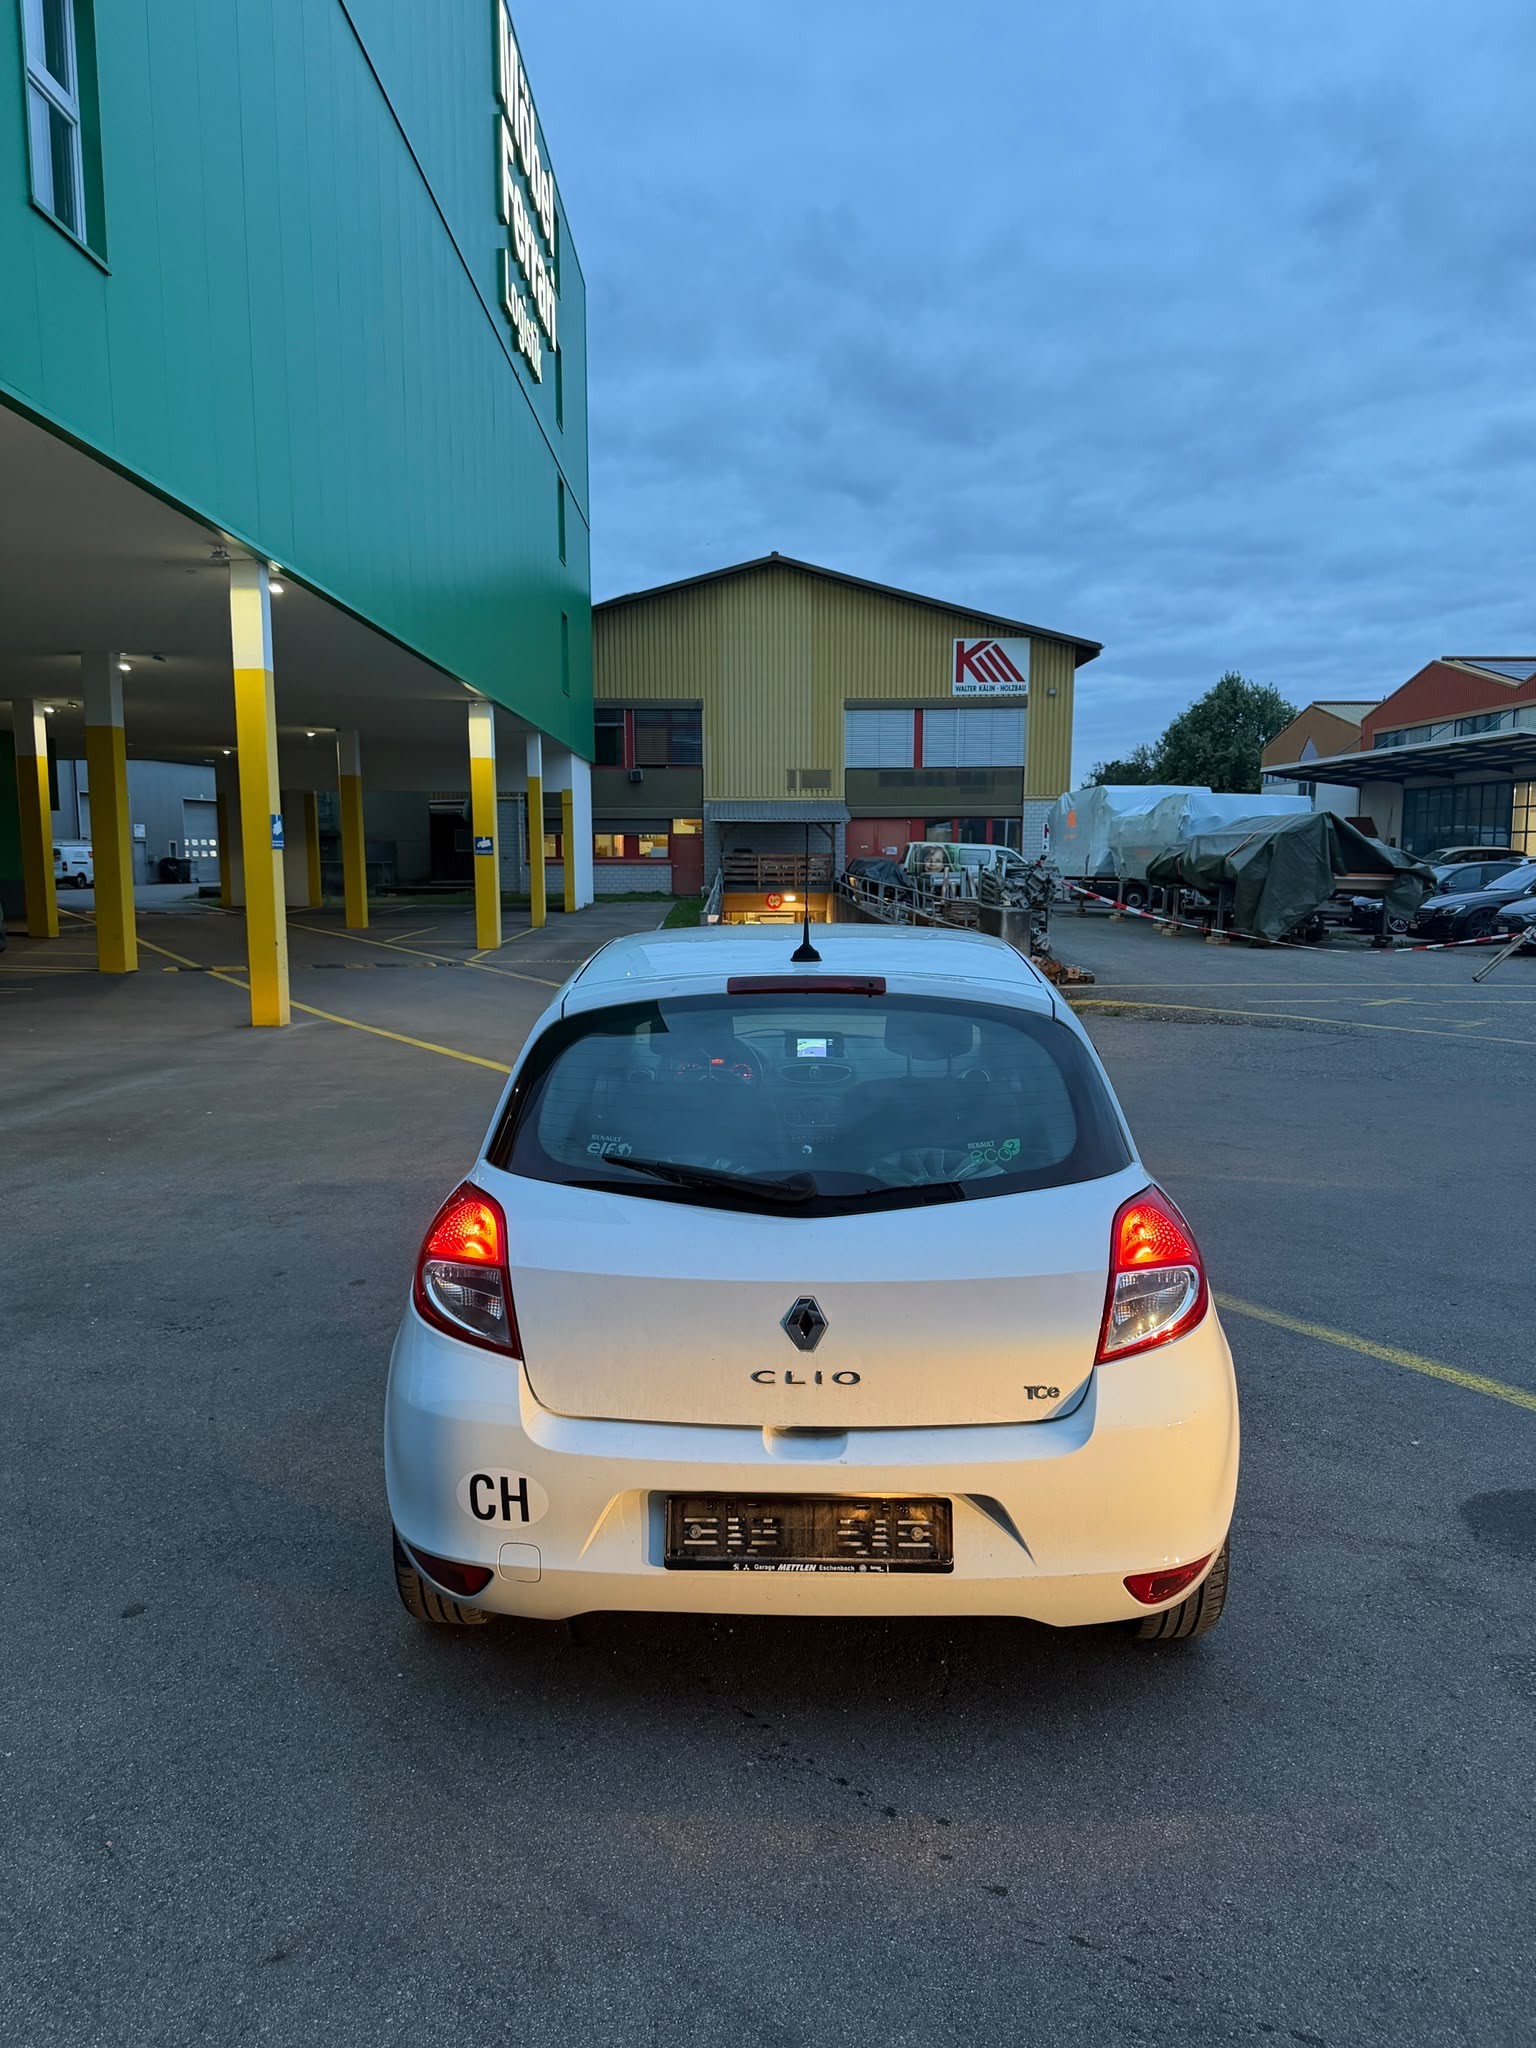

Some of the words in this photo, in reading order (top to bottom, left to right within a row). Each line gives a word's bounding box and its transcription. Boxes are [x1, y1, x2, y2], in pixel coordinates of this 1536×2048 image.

[499, 0, 554, 257] Möbel
[501, 113, 557, 352] Ferrari
[504, 248, 542, 384] Logistik
[591, 1134, 621, 1142] RENAULT
[967, 1140, 995, 1149] RENAULT
[750, 1370, 861, 1385] CLIO
[469, 1473, 530, 1522] CH
[777, 1563, 816, 1572] METTLEN
[819, 1564, 855, 1572] Eschenbach
